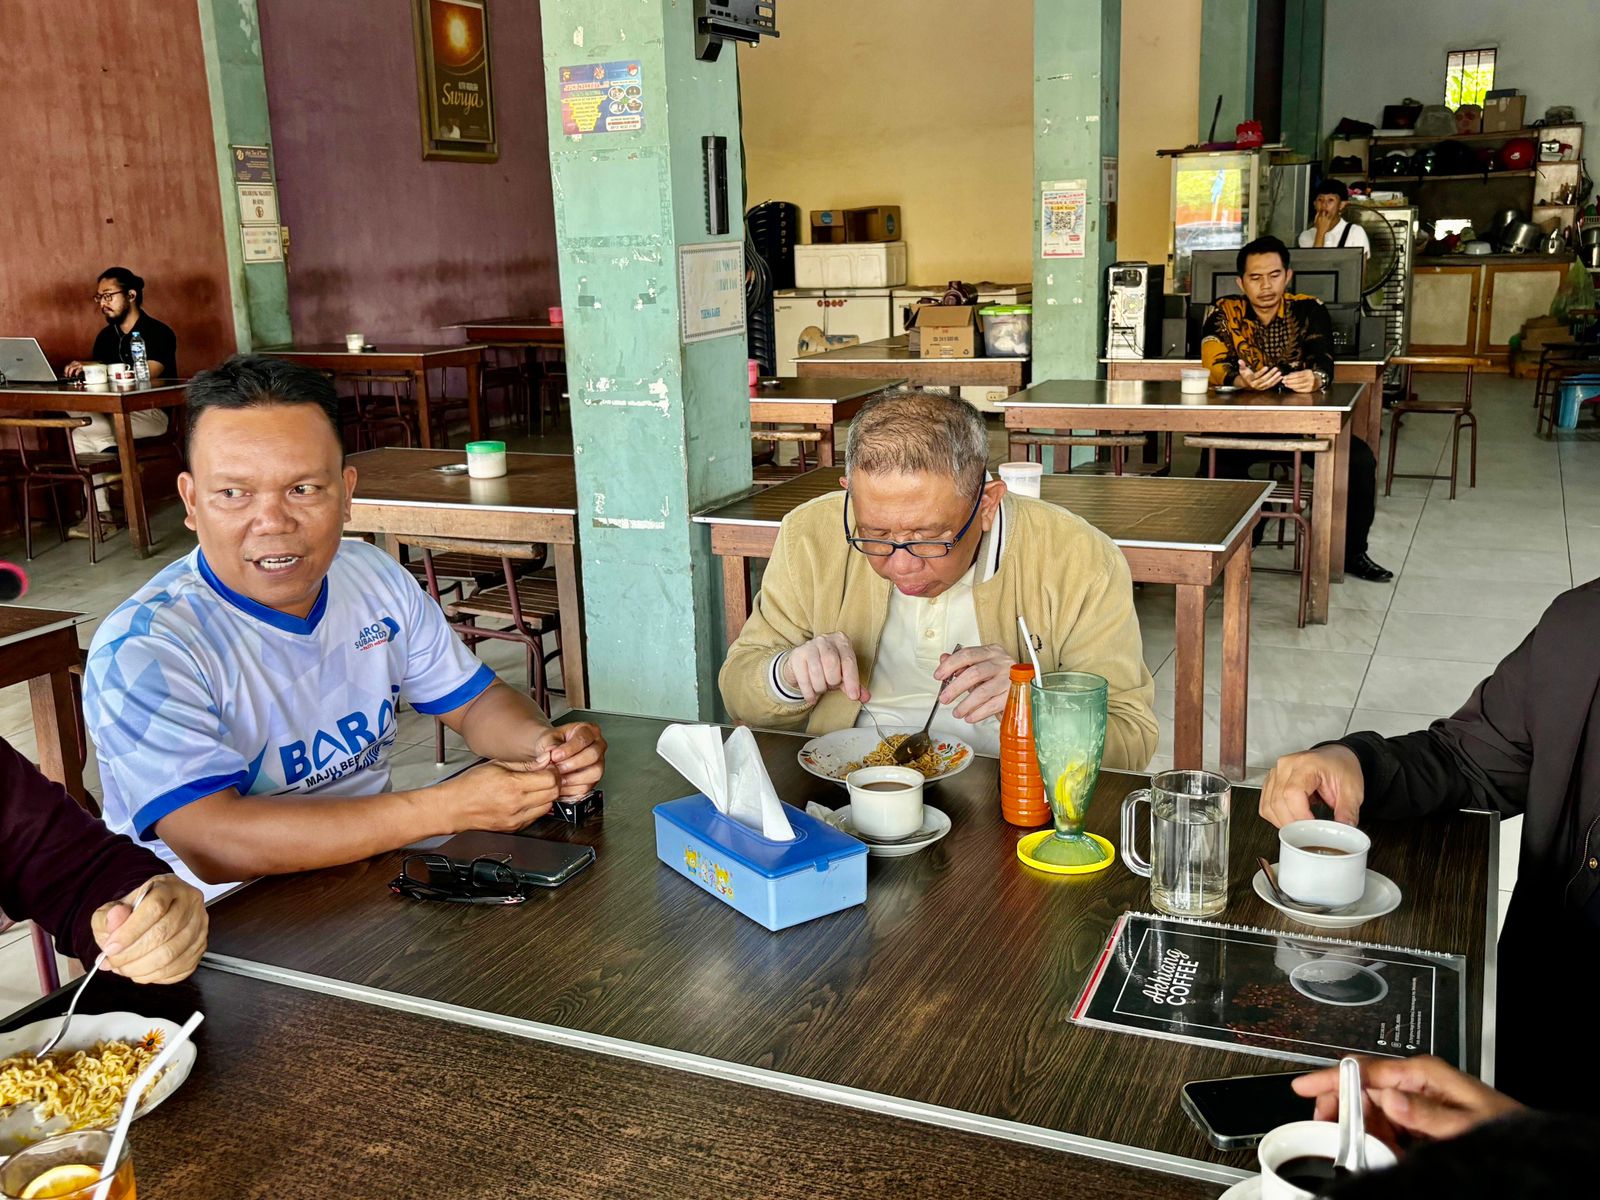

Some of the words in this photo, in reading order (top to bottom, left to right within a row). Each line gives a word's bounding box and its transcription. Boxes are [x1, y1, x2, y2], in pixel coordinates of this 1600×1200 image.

[442, 82, 484, 115] Surya
[360, 624, 380, 641] ARO
[305, 766, 338, 788] MAJU
[1142, 948, 1190, 1004] Akhiang
[1166, 959, 1199, 1006] COFFEE
